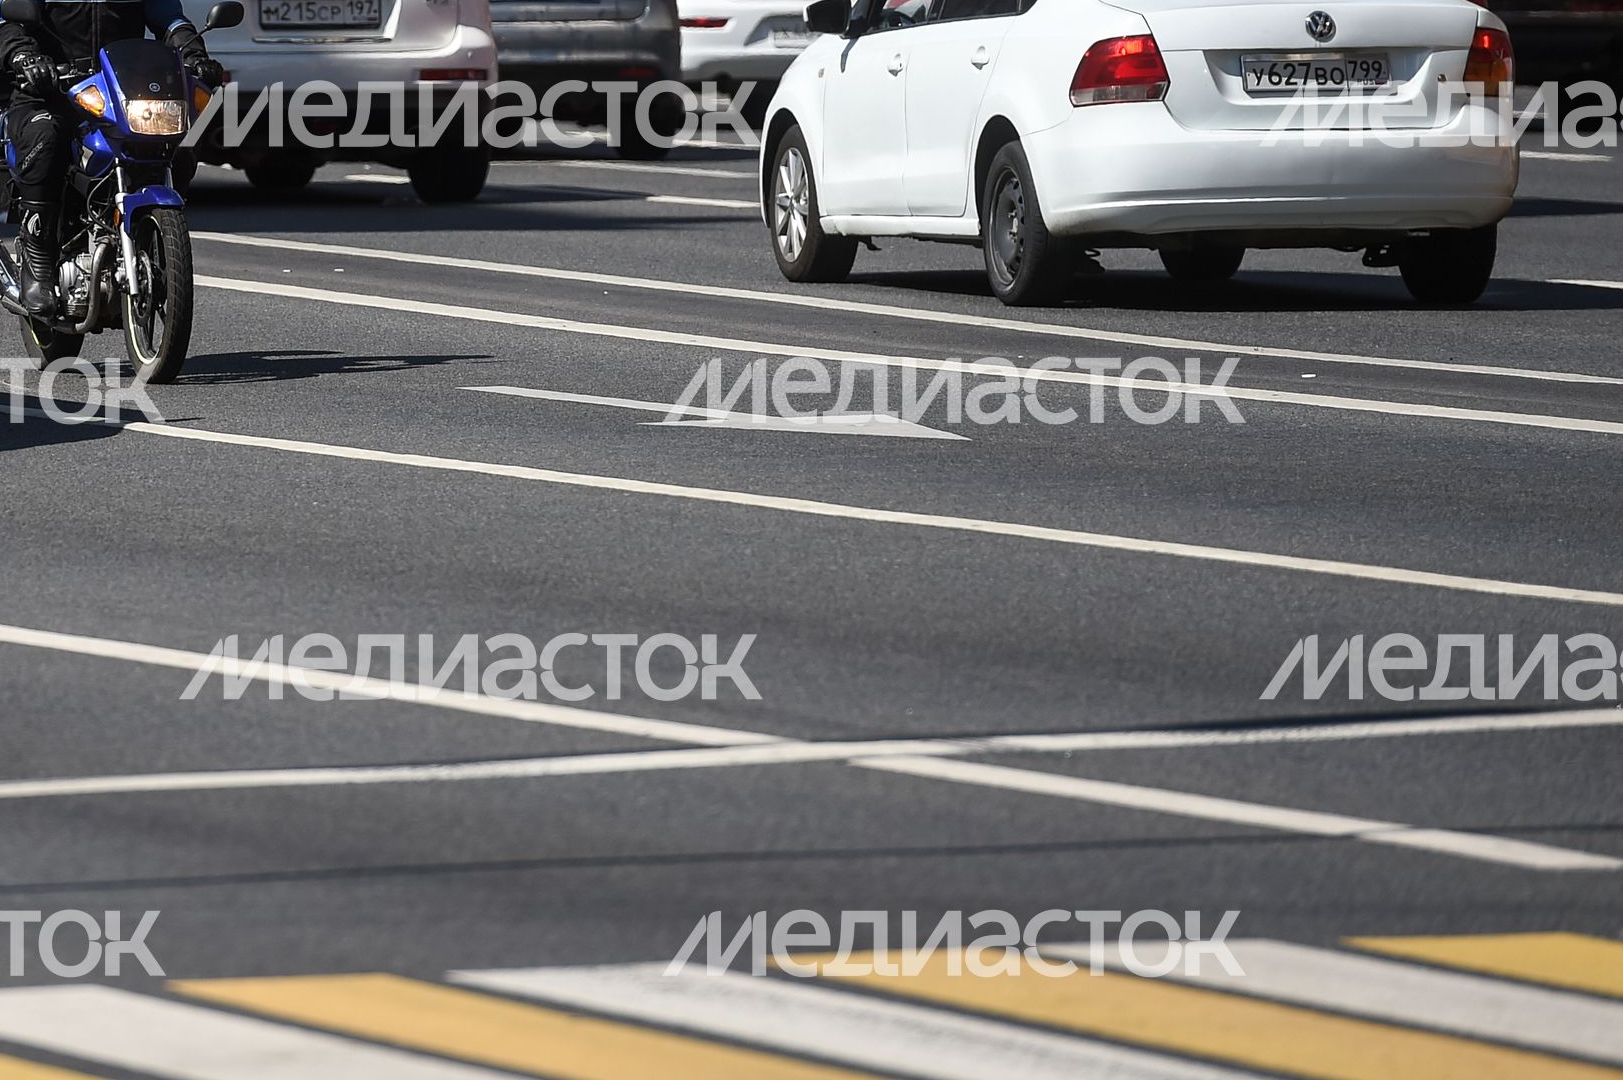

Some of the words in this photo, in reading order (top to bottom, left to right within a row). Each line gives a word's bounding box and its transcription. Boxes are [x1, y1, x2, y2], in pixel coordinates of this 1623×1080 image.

[346, 0, 374, 15] 197
[1251, 62, 1345, 87] У627ВО
[1348, 60, 1383, 79] 799
